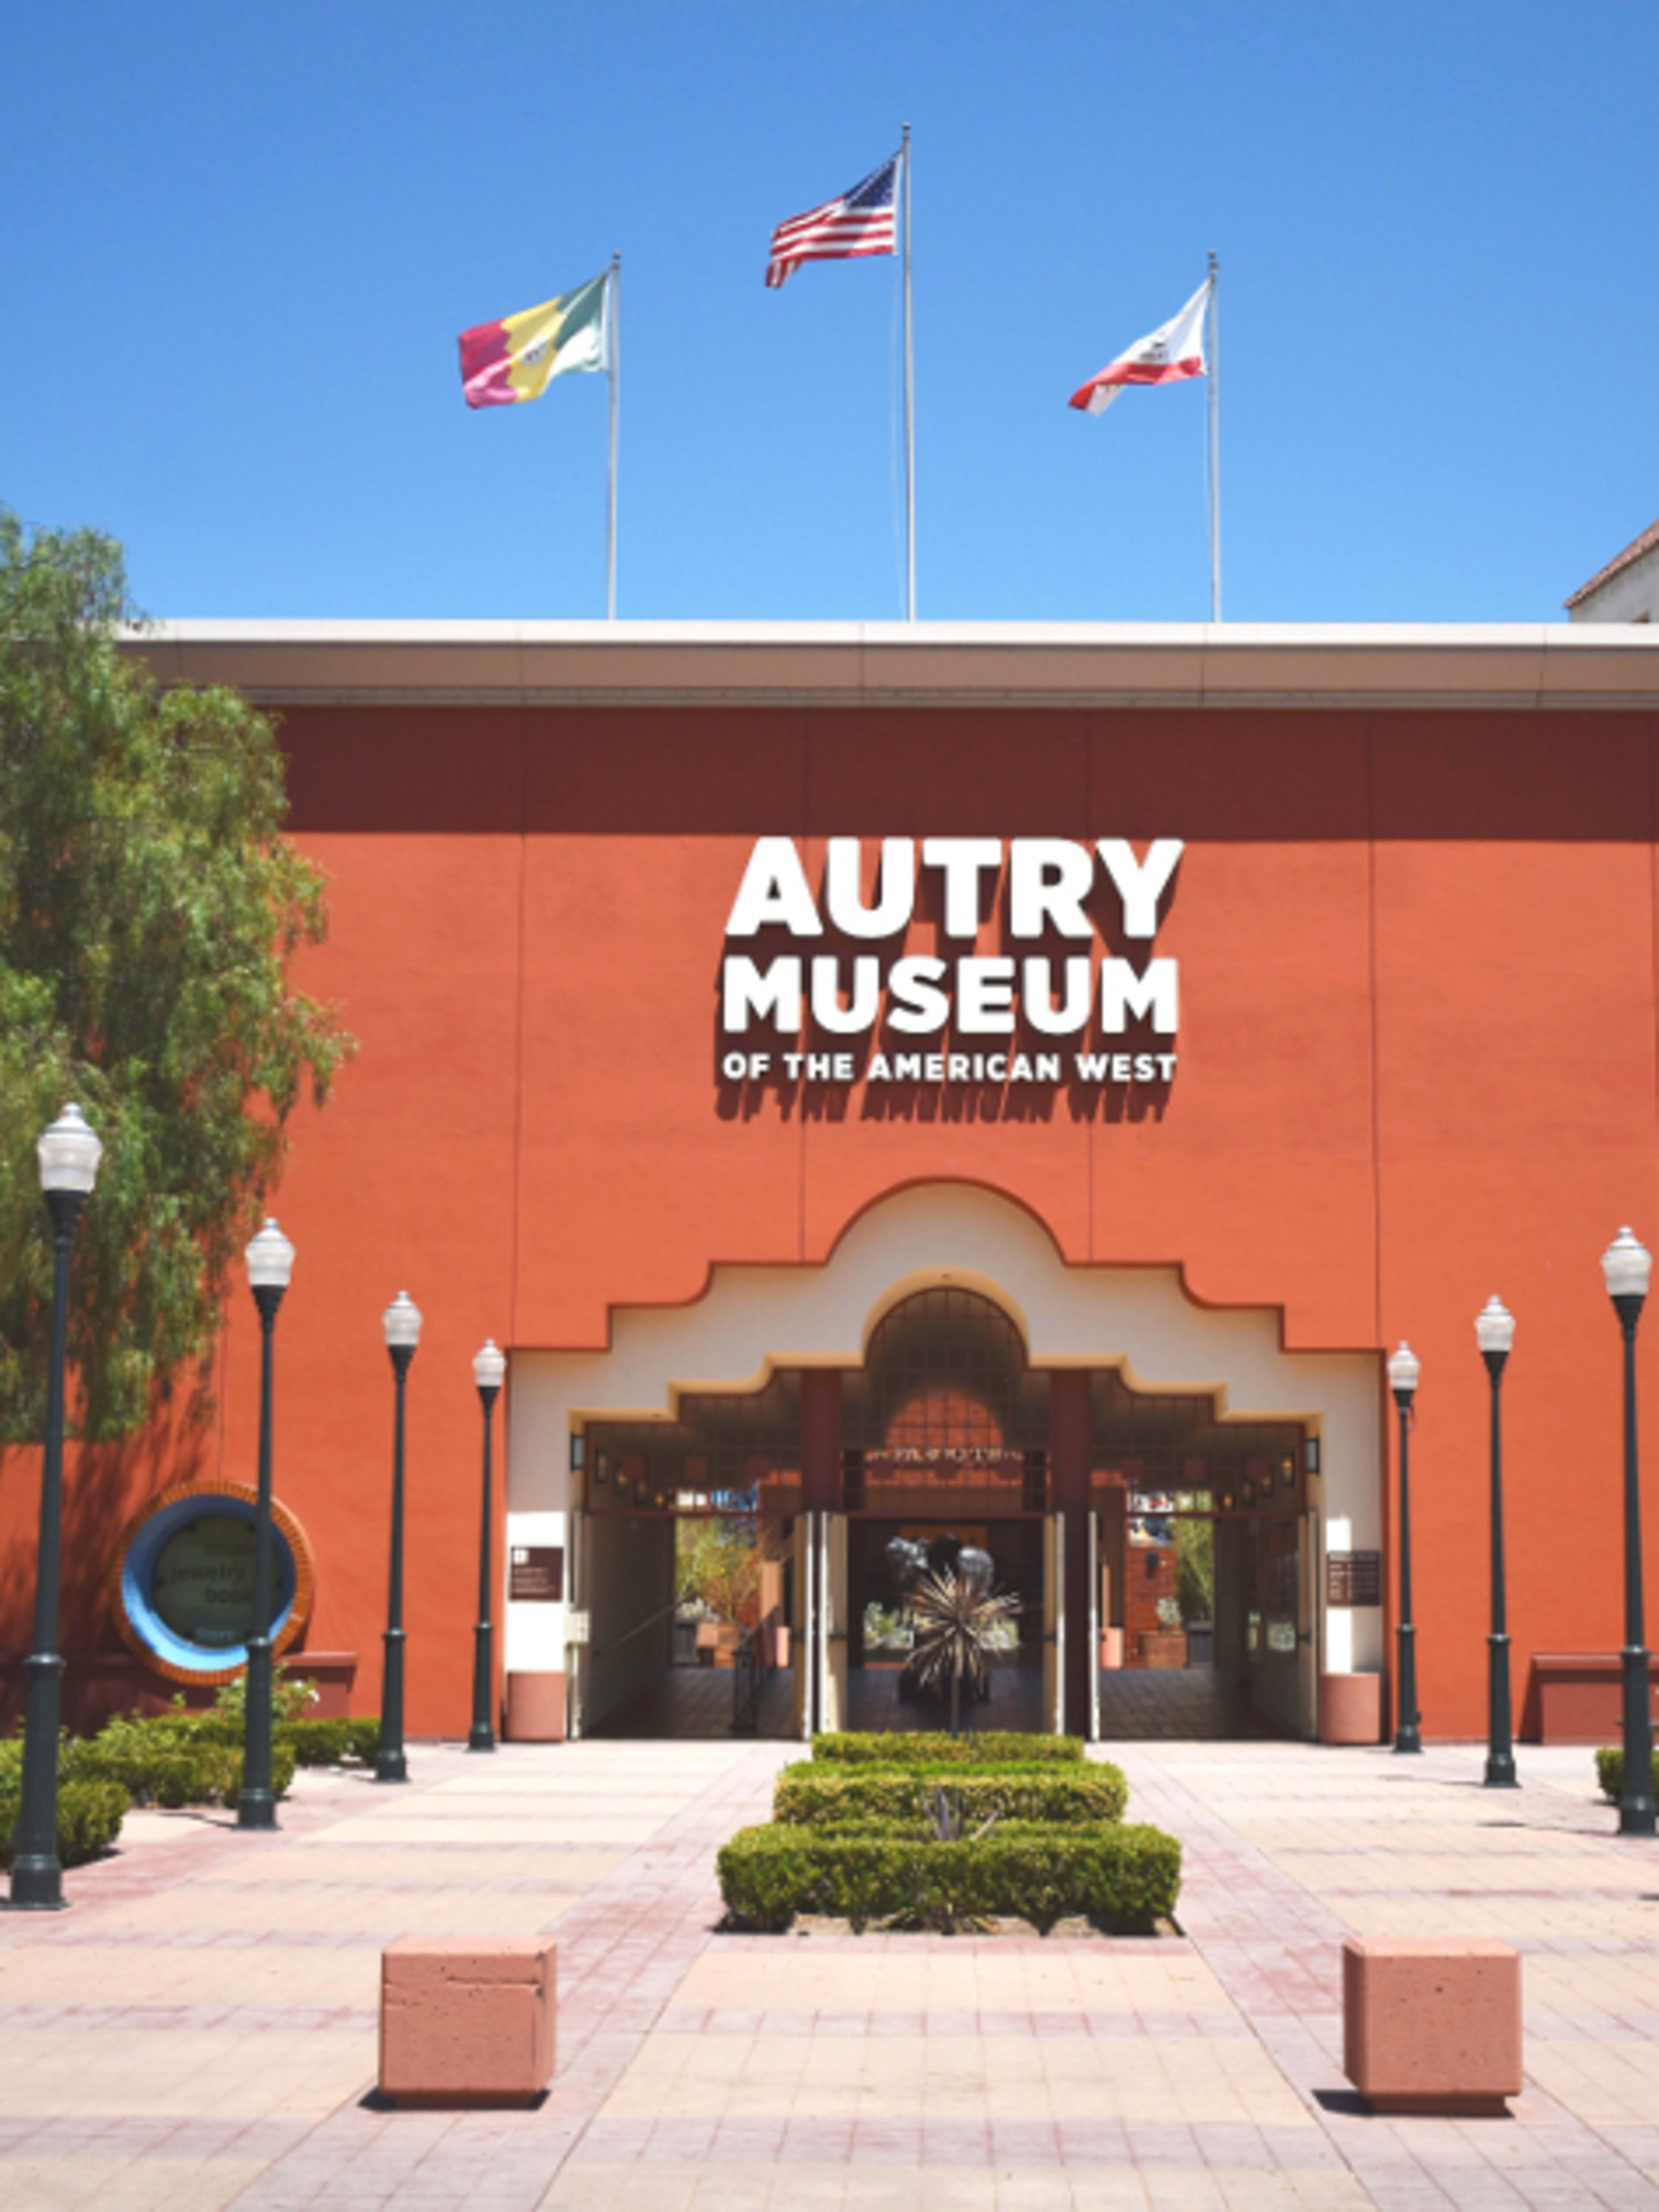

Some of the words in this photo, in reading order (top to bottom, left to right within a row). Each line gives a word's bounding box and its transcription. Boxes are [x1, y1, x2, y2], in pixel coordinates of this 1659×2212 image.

[724, 836, 1185, 938] AUTRY
[724, 955, 1179, 1034] MUSEUM
[723, 1052, 770, 1079] OF
[783, 1053, 854, 1080] THE
[867, 1053, 1060, 1081] AMERICAN
[1075, 1054, 1177, 1081] WEST
